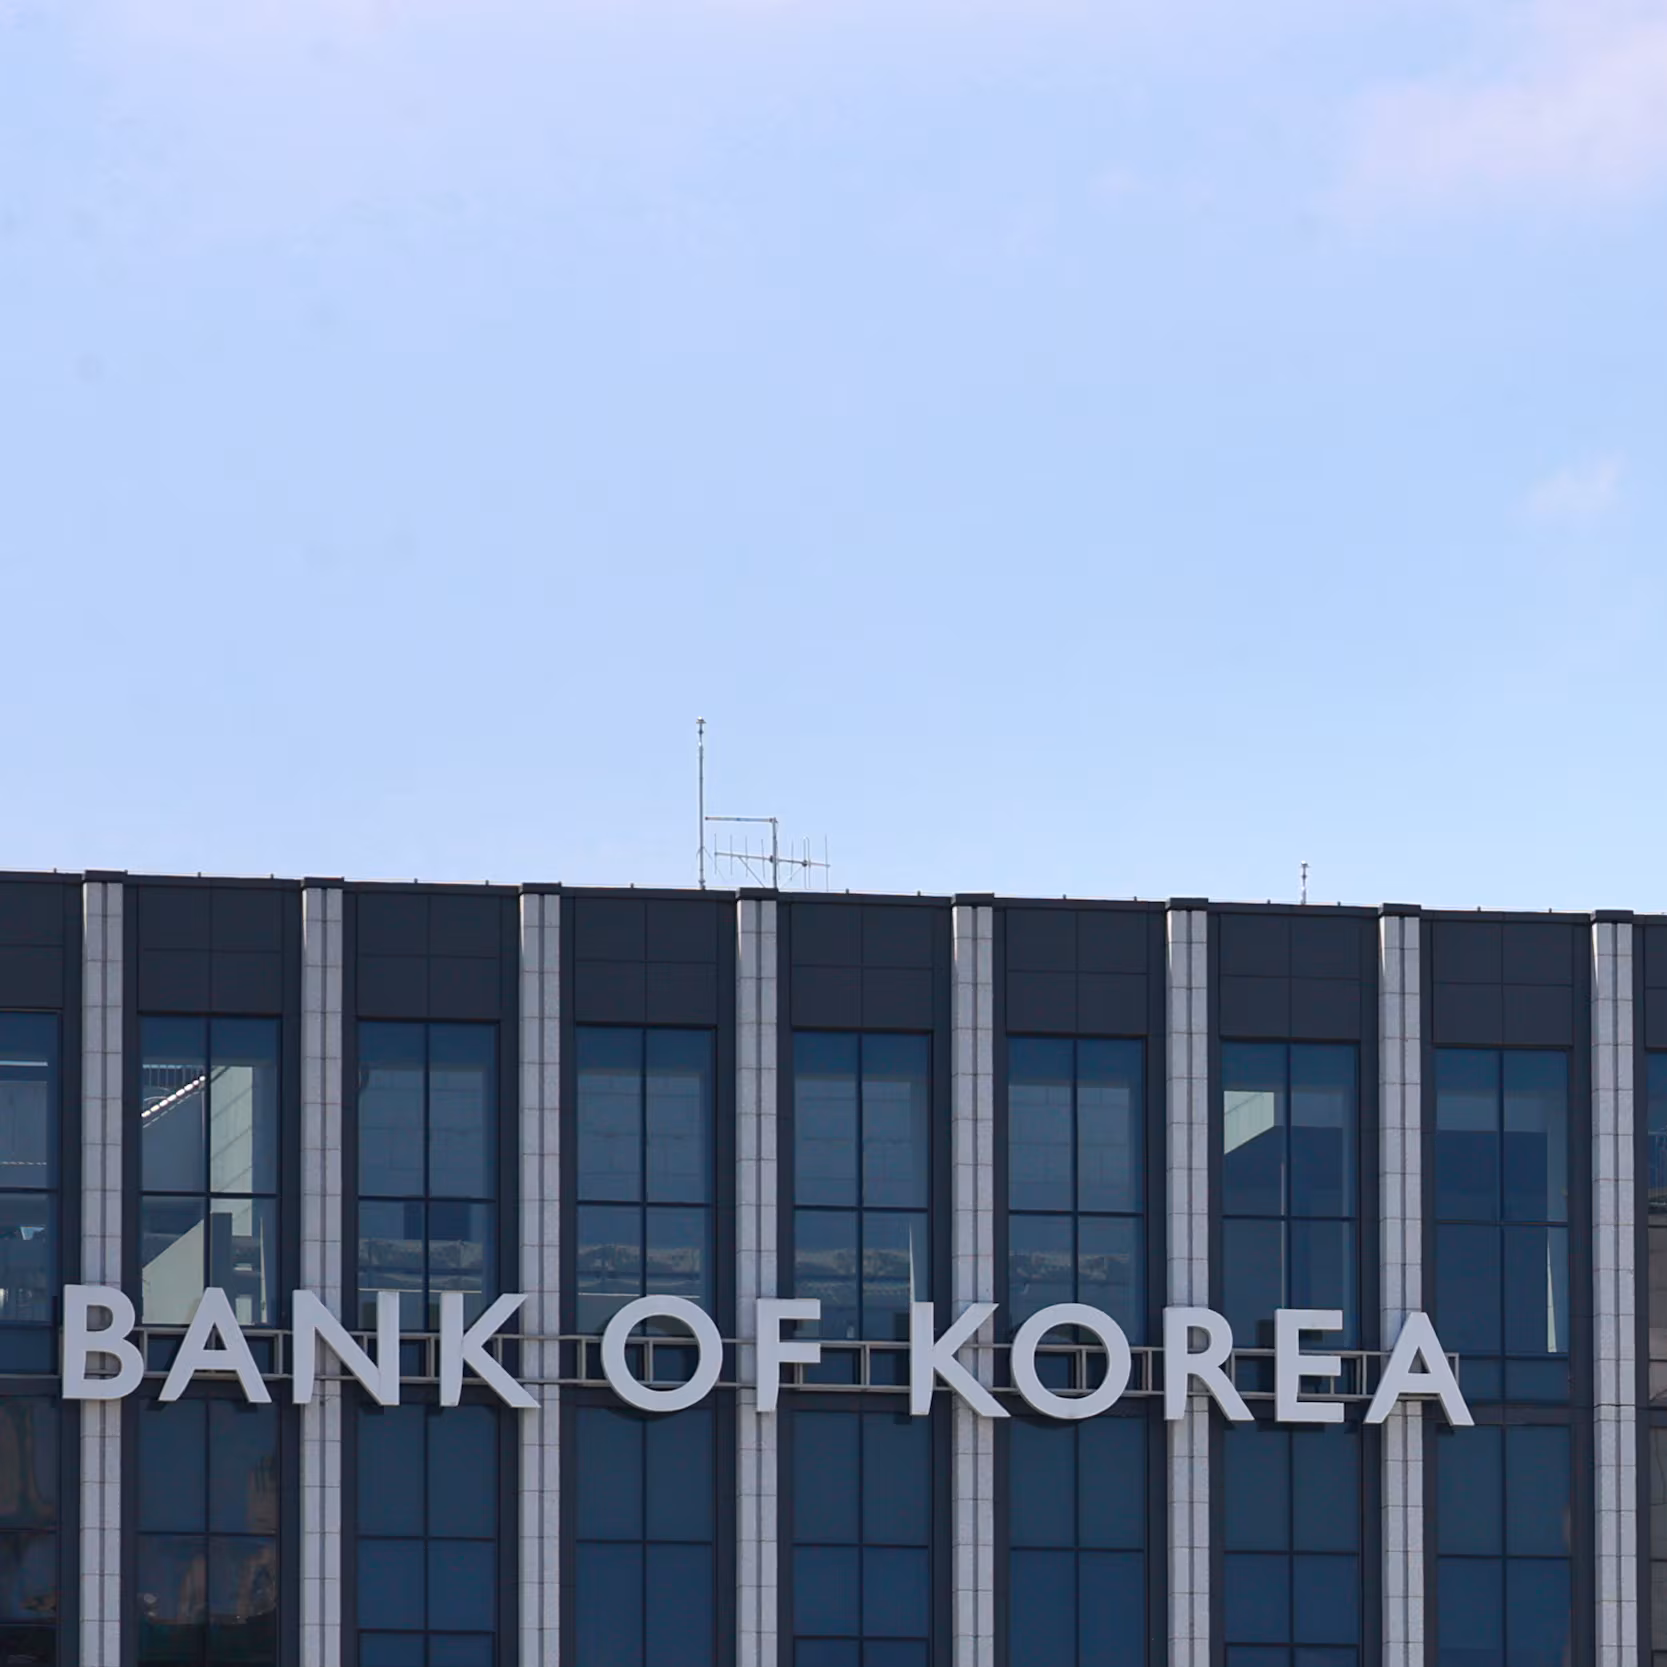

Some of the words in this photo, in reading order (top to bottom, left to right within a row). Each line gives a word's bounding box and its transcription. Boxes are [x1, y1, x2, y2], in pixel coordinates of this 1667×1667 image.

[62, 1284, 541, 1408] BANK
[601, 1295, 821, 1412] OF
[910, 1302, 1475, 1426] KOREA
